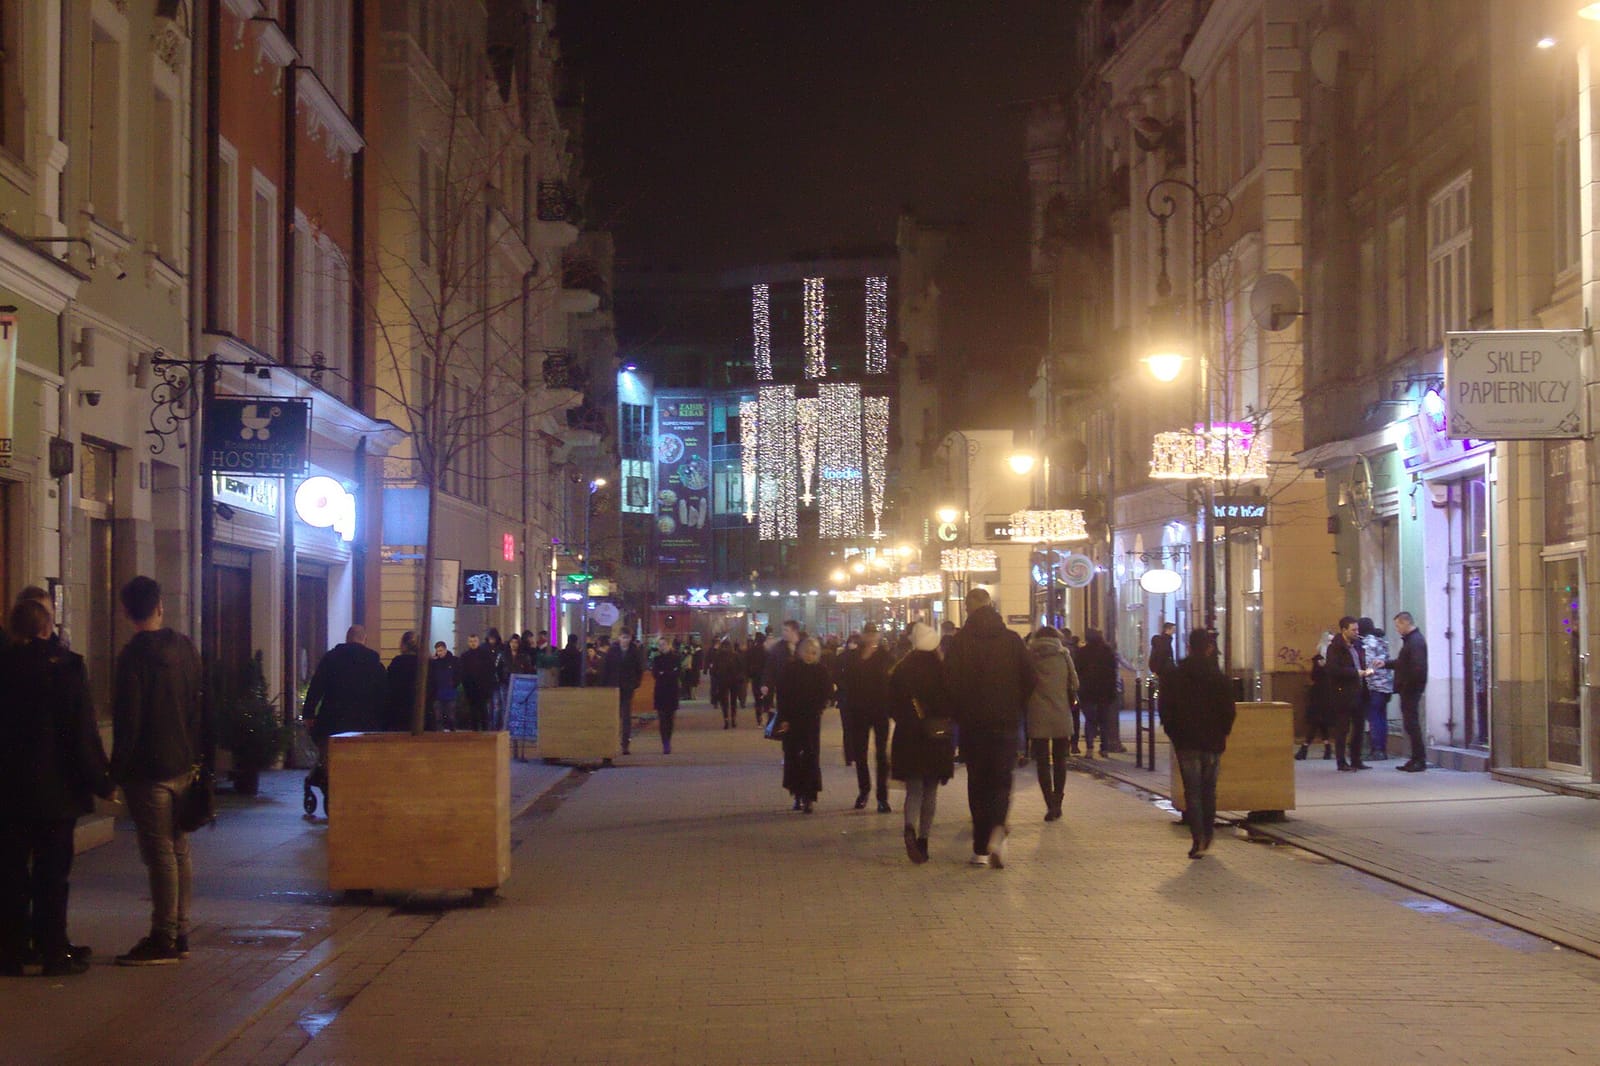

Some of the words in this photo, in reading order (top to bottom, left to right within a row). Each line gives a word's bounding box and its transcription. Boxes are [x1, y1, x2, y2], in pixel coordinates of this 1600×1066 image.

[1487, 351, 1542, 374] SKLEP
[1460, 381, 1570, 403] PAPIERNICZY
[211, 450, 299, 469] HOSTEL
